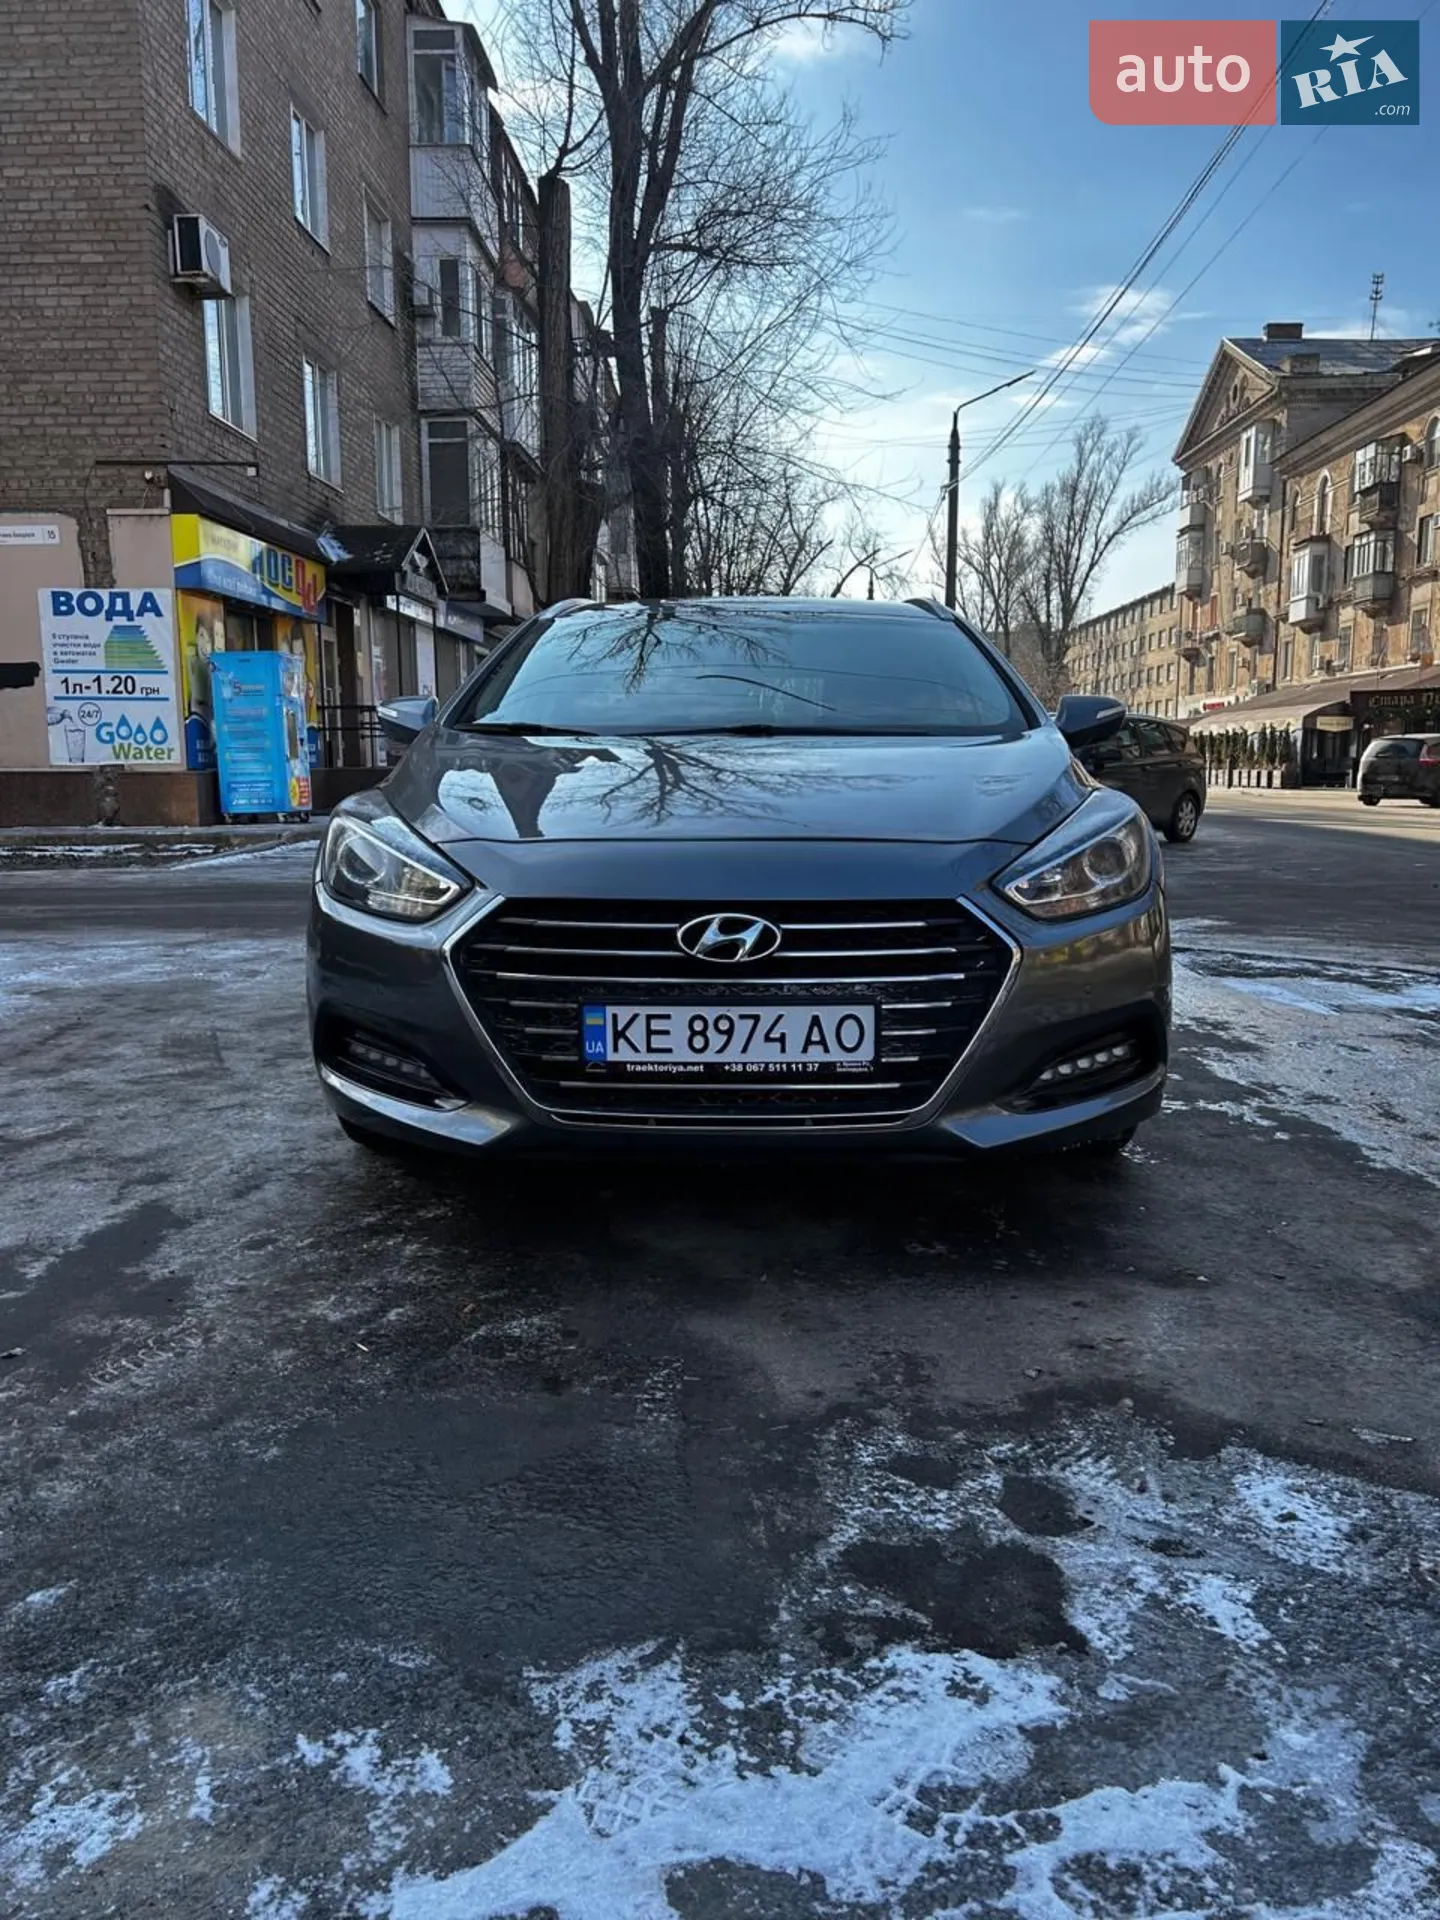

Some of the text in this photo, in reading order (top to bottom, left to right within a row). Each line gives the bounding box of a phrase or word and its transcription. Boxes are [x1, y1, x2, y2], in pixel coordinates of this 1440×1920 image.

[51, 591, 164, 622] ВОДА
[141, 686, 160, 697] грн
[80, 709, 99, 719] 24/7
[112, 742, 174, 760] Water
[611, 1012, 865, 1054] KE 8974 AO
[586, 1041, 604, 1053] UA
[626, 1063, 820, 1073] traektoriya.net +38 067 511 11 37
